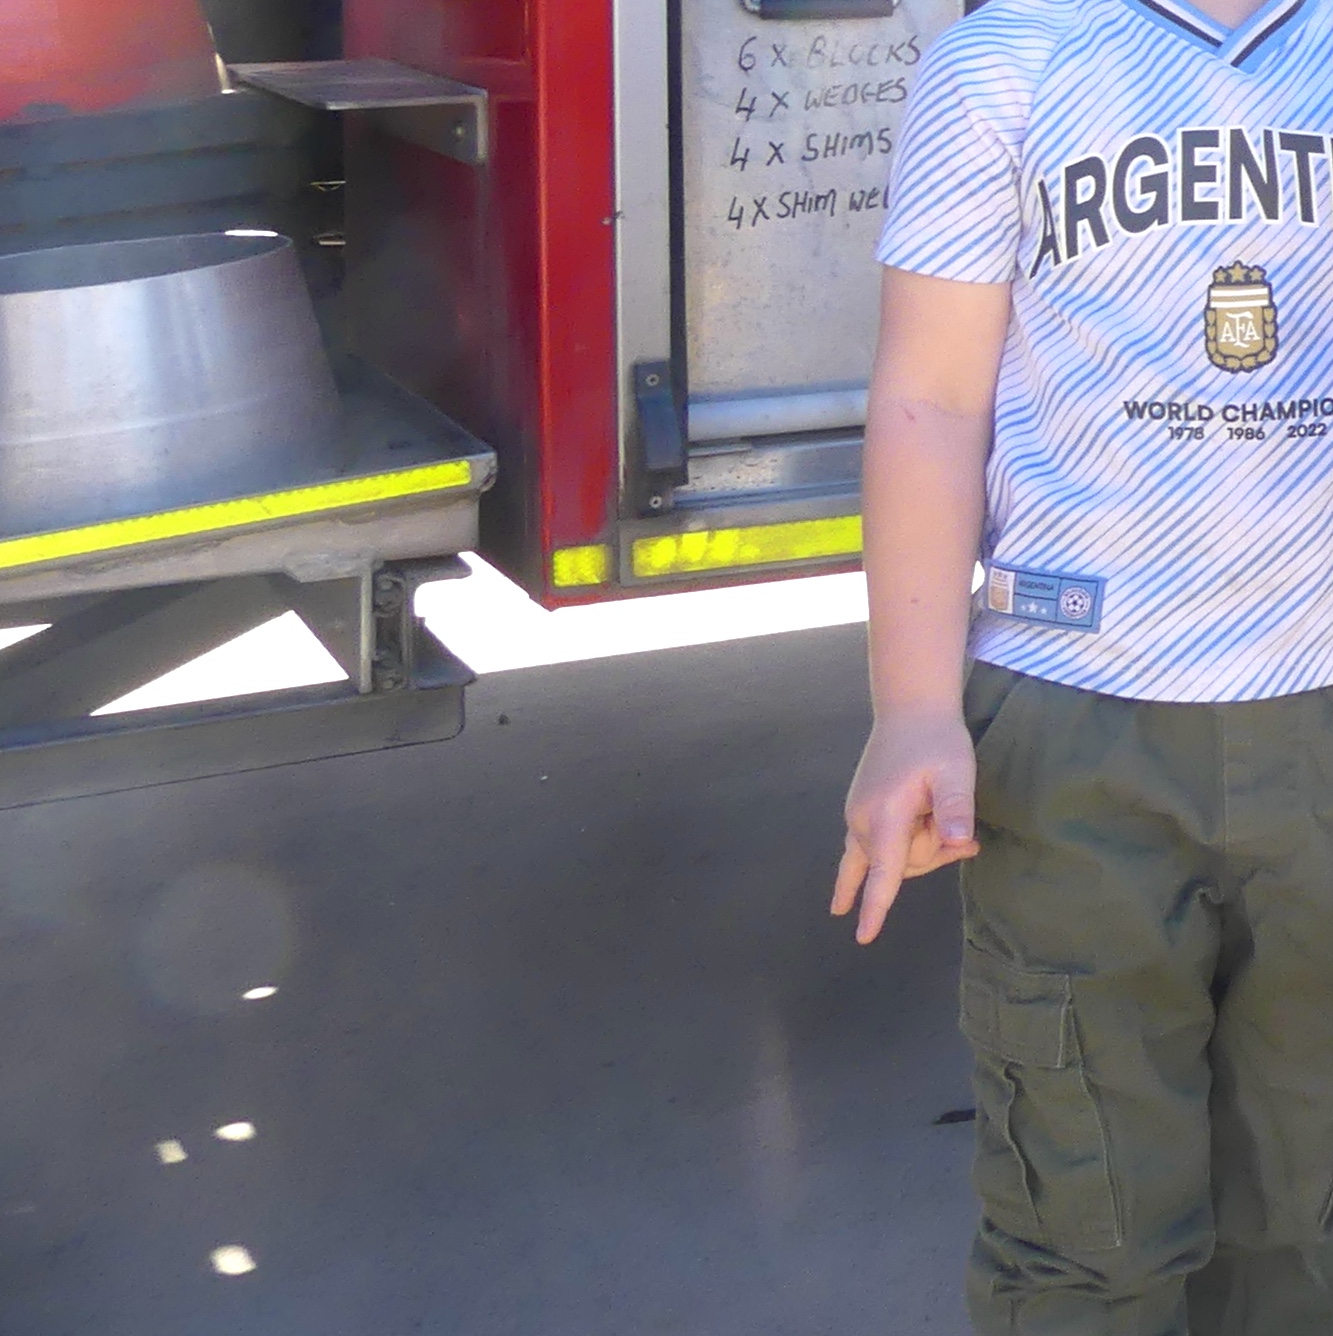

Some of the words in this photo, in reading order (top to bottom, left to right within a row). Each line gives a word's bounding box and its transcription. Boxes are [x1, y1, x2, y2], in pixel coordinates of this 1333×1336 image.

[738, 35, 758, 73] 6
[734, 86, 758, 123] 4
[802, 76, 908, 112] WEDGES
[729, 136, 751, 172] 4
[800, 126, 894, 162] SHIMS
[776, 187, 837, 220] SHIM
[1219, 310, 1262, 349] AFA
[1122, 400, 1215, 422] WORLD
[1167, 426, 1205, 441] 1978
[1226, 426, 1266, 441] 1986
[1286, 422, 1328, 439] 2022
